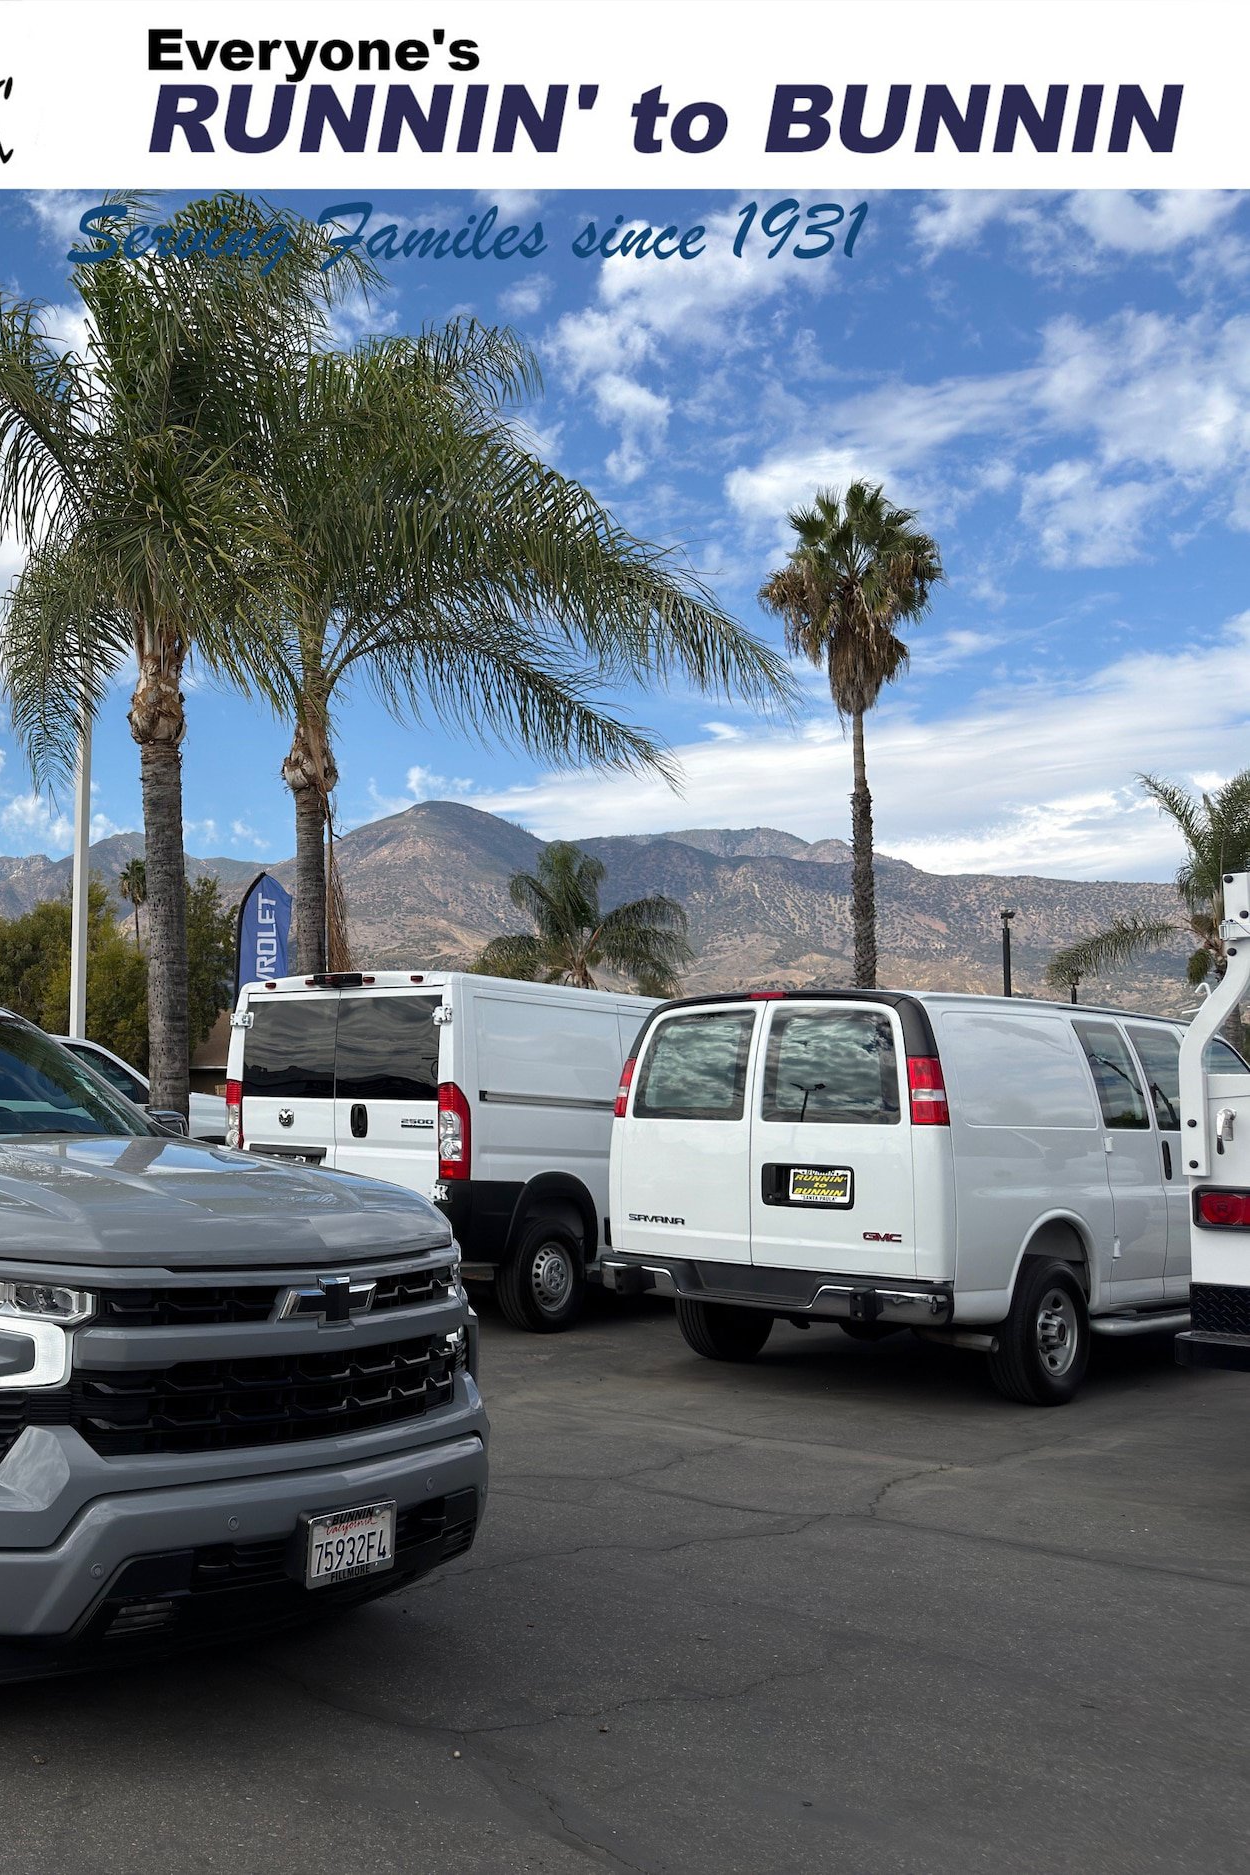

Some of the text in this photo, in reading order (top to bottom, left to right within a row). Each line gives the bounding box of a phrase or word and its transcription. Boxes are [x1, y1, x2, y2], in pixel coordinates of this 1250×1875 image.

[793, 1187, 845, 1197] BUNNIN
[628, 1213, 685, 1226] SAVANA
[862, 1231, 902, 1243] GMC
[332, 1507, 375, 1526] BUNNIN
[314, 1529, 387, 1575] 75932F4
[330, 1564, 370, 1583] FILLMORE
